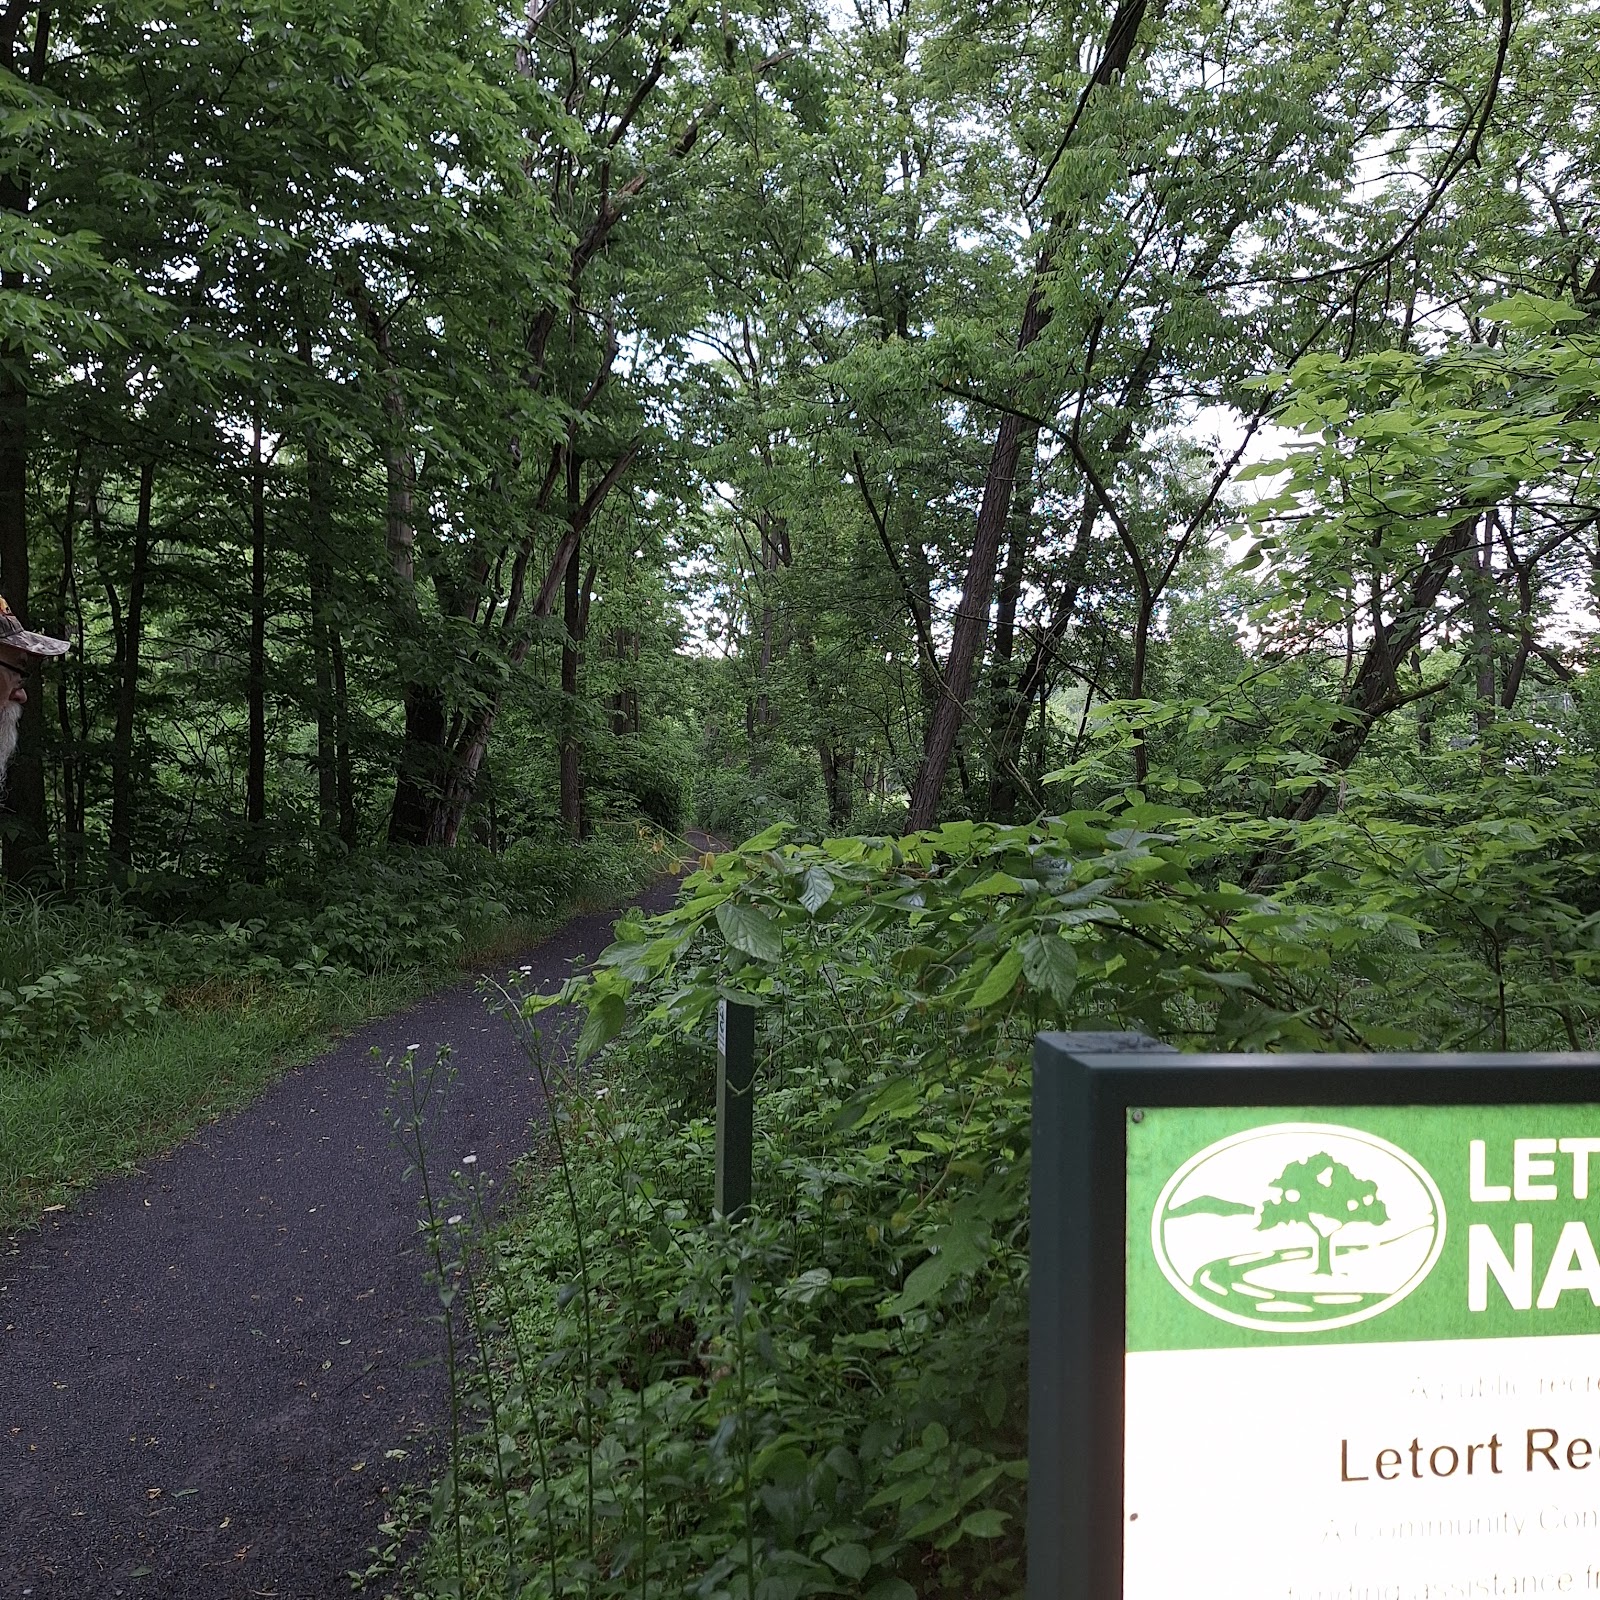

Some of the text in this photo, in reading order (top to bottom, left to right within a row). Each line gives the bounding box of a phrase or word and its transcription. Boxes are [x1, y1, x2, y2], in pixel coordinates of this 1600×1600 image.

[1470, 1138, 1600, 1202] LET
[1468, 1221, 1600, 1312] NA
[1341, 1428, 1600, 1482] Letort Re
[1354, 1509, 1525, 1540] Community
[1540, 1504, 1598, 1530] Con
